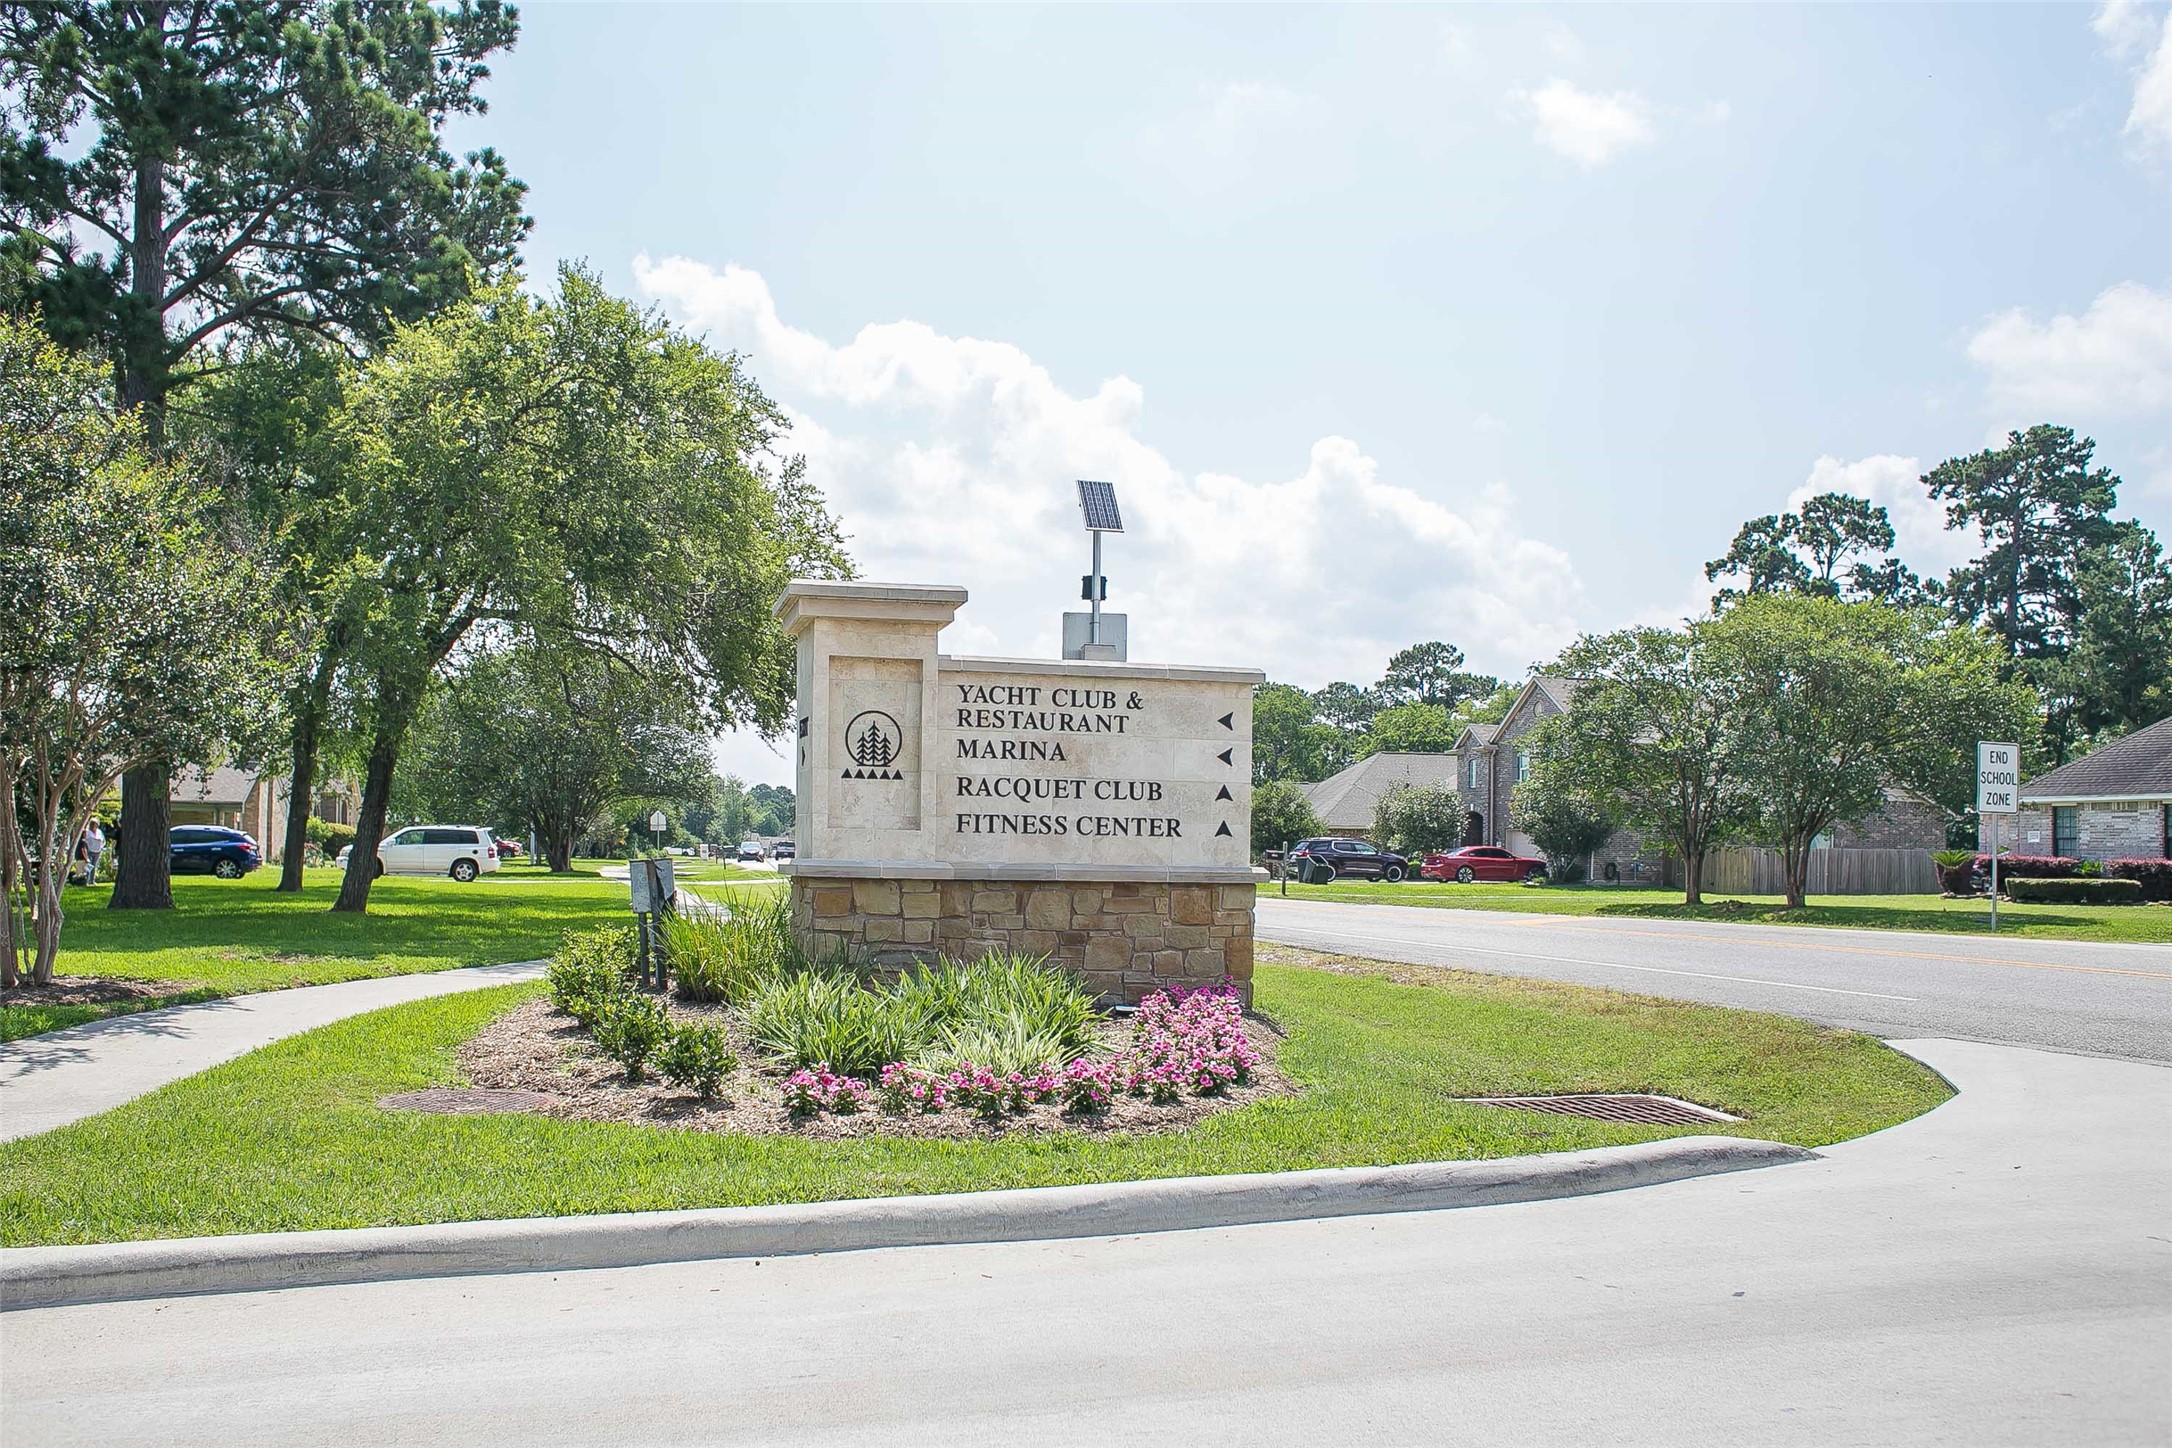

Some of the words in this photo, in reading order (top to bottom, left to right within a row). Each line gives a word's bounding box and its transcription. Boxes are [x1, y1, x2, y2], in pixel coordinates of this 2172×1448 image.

[957, 684, 1042, 706] YACHT
[1051, 688, 1117, 709] CLUB
[1126, 691, 1144, 710] &
[957, 708, 1130, 733] RESTAURANT
[956, 739, 1067, 762] MARINA
[1990, 751, 2008, 764] END
[956, 776, 1087, 803] RACQUET
[1094, 781, 1163, 801] CLUB
[1981, 771, 2017, 785] SCHOOL
[1986, 792, 2010, 806] ZONE
[955, 813, 1068, 836] FITNESS
[1076, 816, 1183, 838] CENTER
